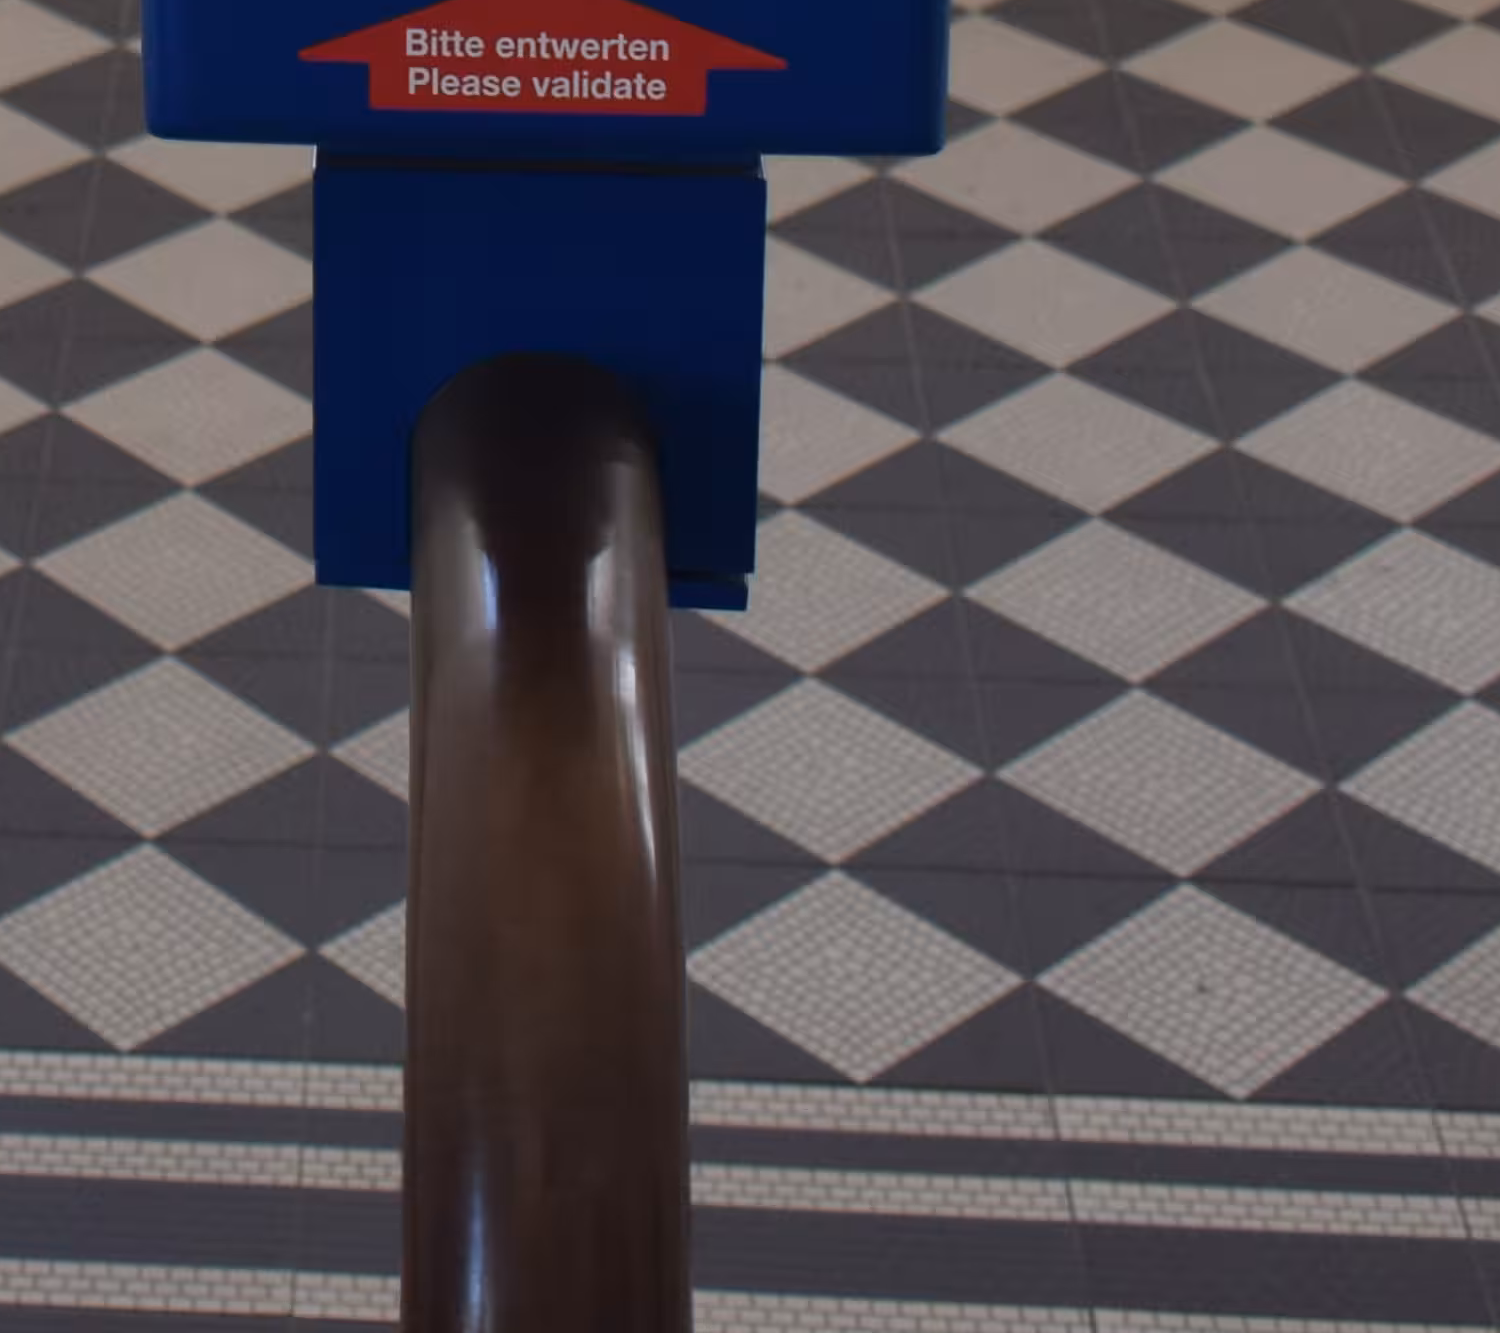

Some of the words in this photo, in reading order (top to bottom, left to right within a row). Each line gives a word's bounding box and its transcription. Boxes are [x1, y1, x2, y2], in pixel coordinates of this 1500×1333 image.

[405, 27, 485, 58] Bitte
[495, 31, 670, 62] entwerten
[408, 66, 521, 98] Please
[531, 69, 667, 101] validate
